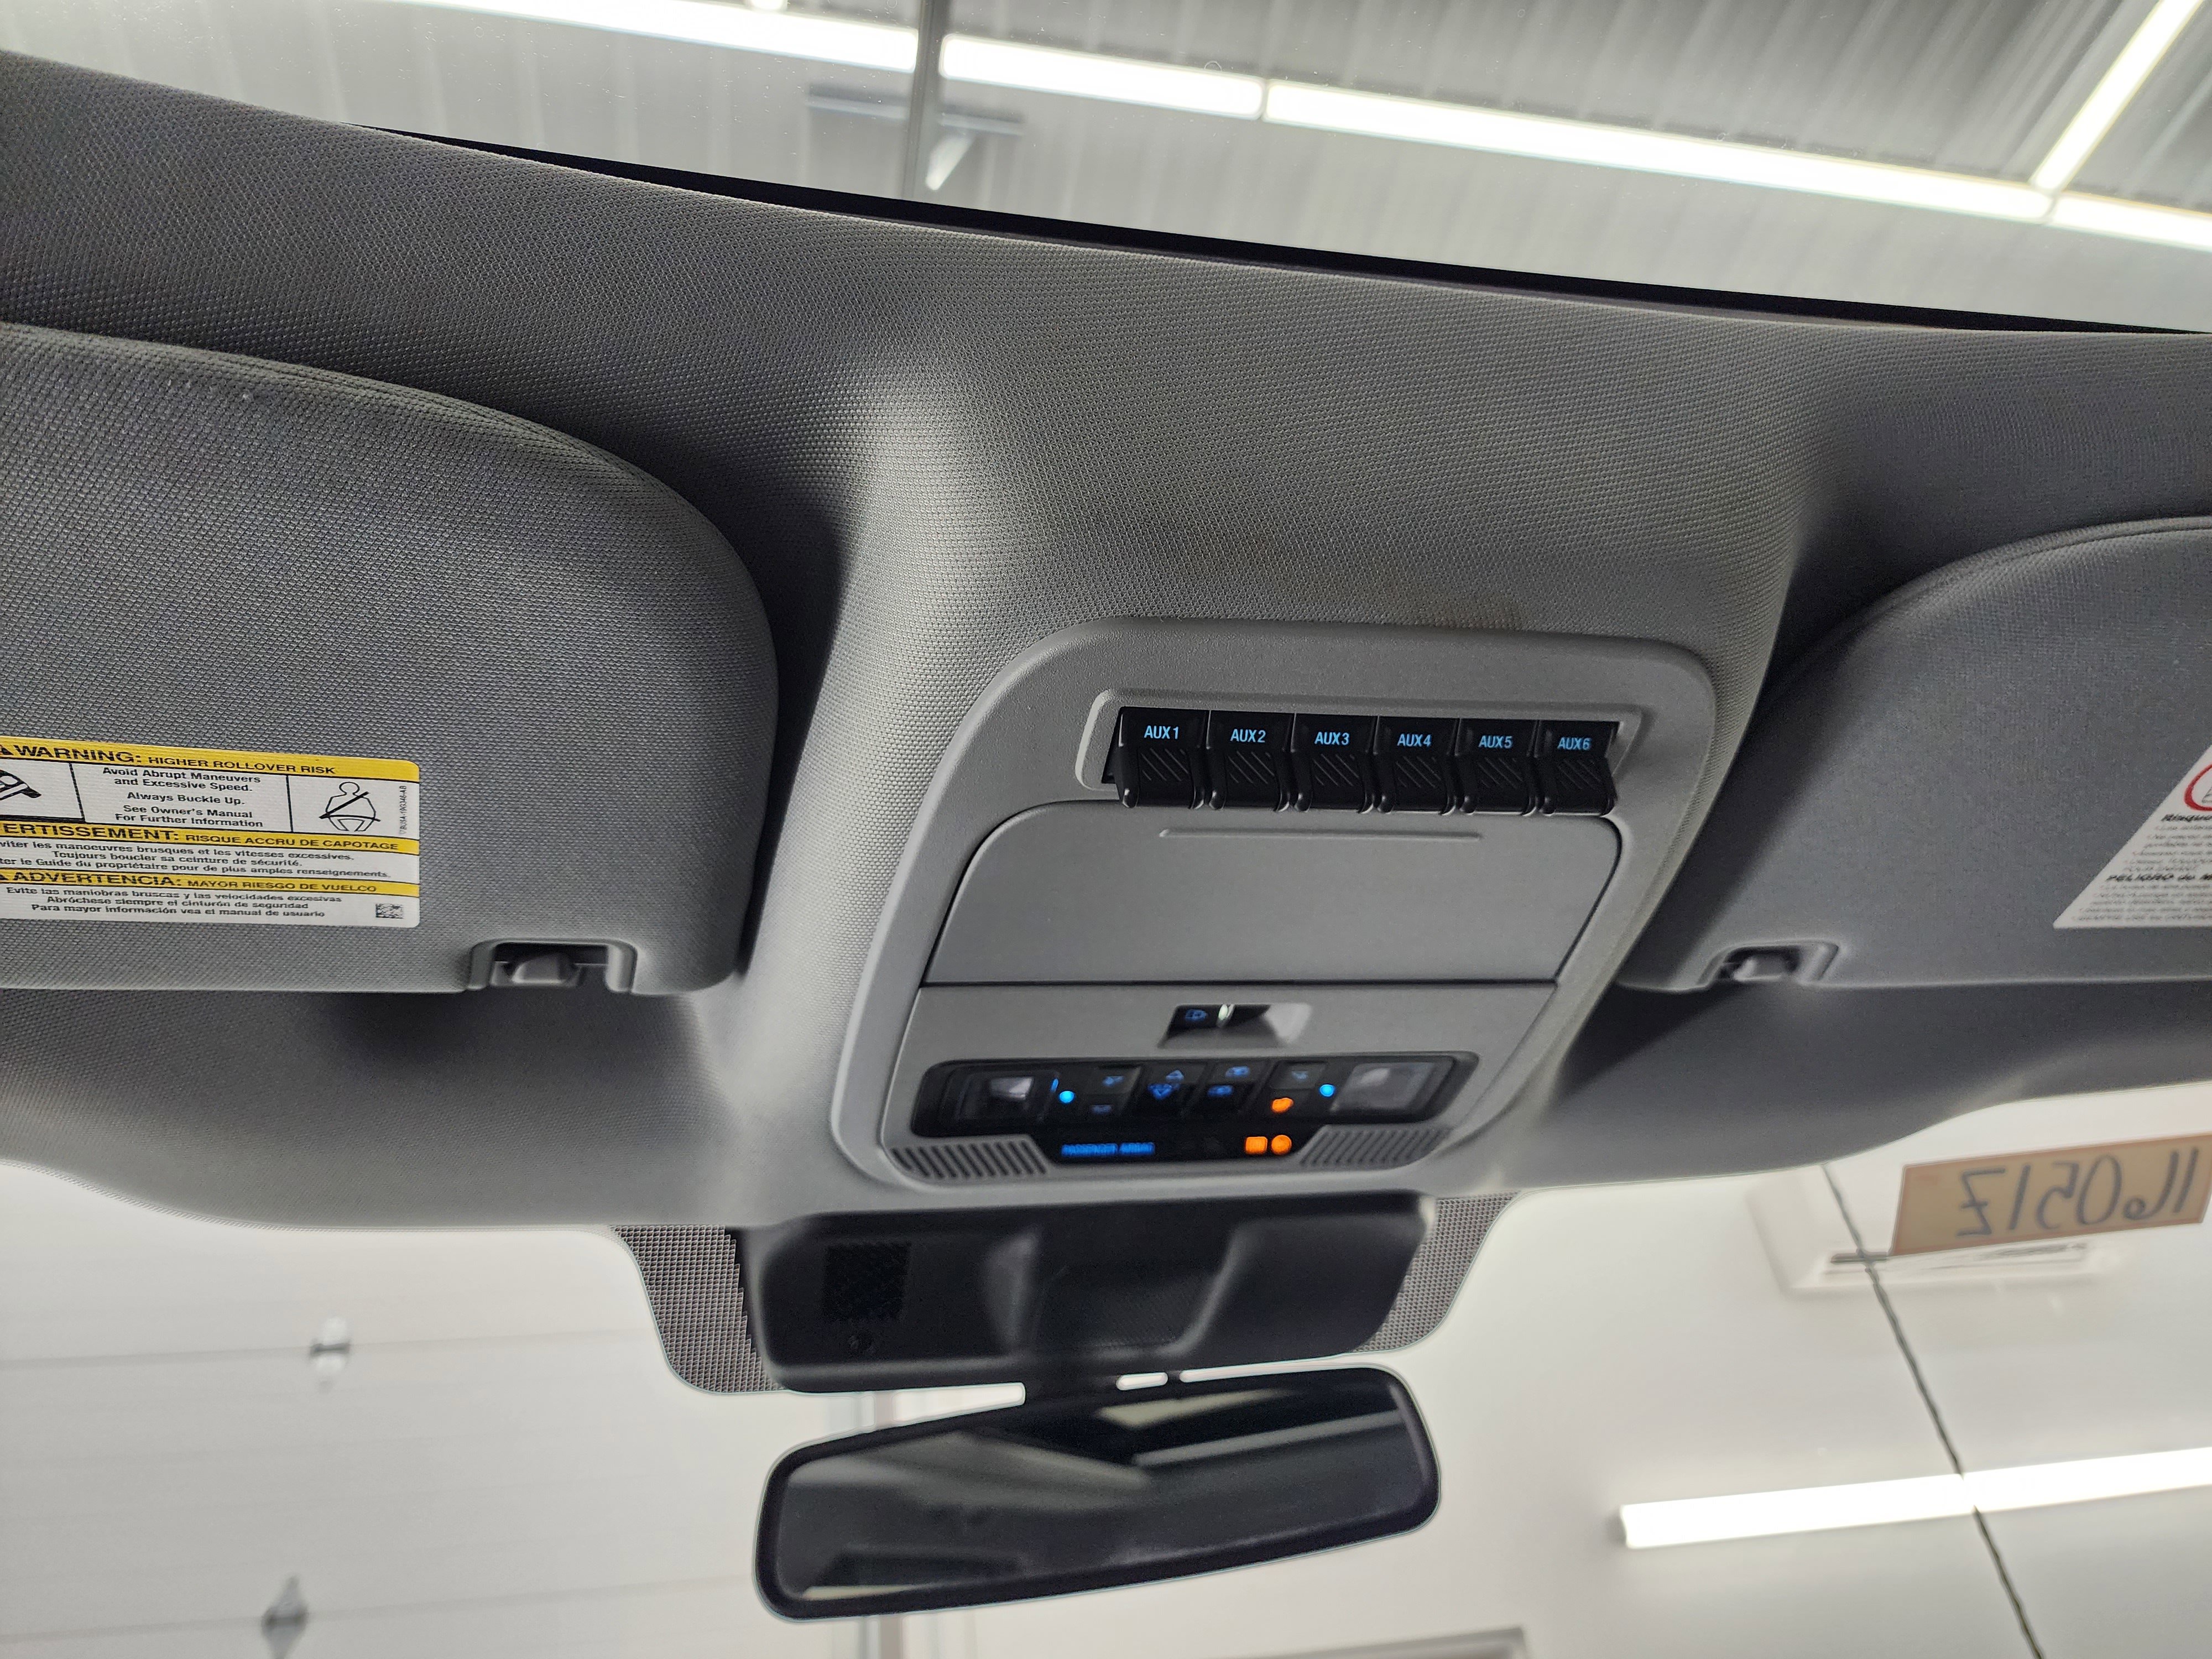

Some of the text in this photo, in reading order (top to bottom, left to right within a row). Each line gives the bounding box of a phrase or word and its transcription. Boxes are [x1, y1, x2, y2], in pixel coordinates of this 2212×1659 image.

[13, 744, 336, 774] WARNING: HIGHER ROLLOVER RISK
[103, 767, 261, 783] Avoid Abrupt Maneuvers
[142, 779, 206, 789] Excessive
[210, 782, 253, 791] Speed.
[127, 791, 245, 805] Always Buckle Up.
[150, 806, 203, 816] Owner's
[206, 809, 253, 818] Manual
[115, 813, 263, 827] For Further Information
[185, 834, 242, 843] RISQUE
[245, 837, 295, 846] ACCRU
[300, 838, 319, 847] DE
[322, 839, 399, 850] CAPOTAGE
[51, 851, 106, 859] Toujours
[110, 853, 156, 861] boucler
[55, 843, 133, 853] manoeuvres
[137, 846, 194, 855] brusques
[288, 852, 354, 860] excessives.
[36, 858, 72, 867] Guide
[95, 862, 168, 870] propriétaire
[13, 872, 182, 886] ADVERTENCIA:
[187, 880, 238, 888] MAYOR
[321, 884, 377, 892] VUELCO
[47, 896, 112, 904] Abróchese
[114, 898, 163, 906] siempre
